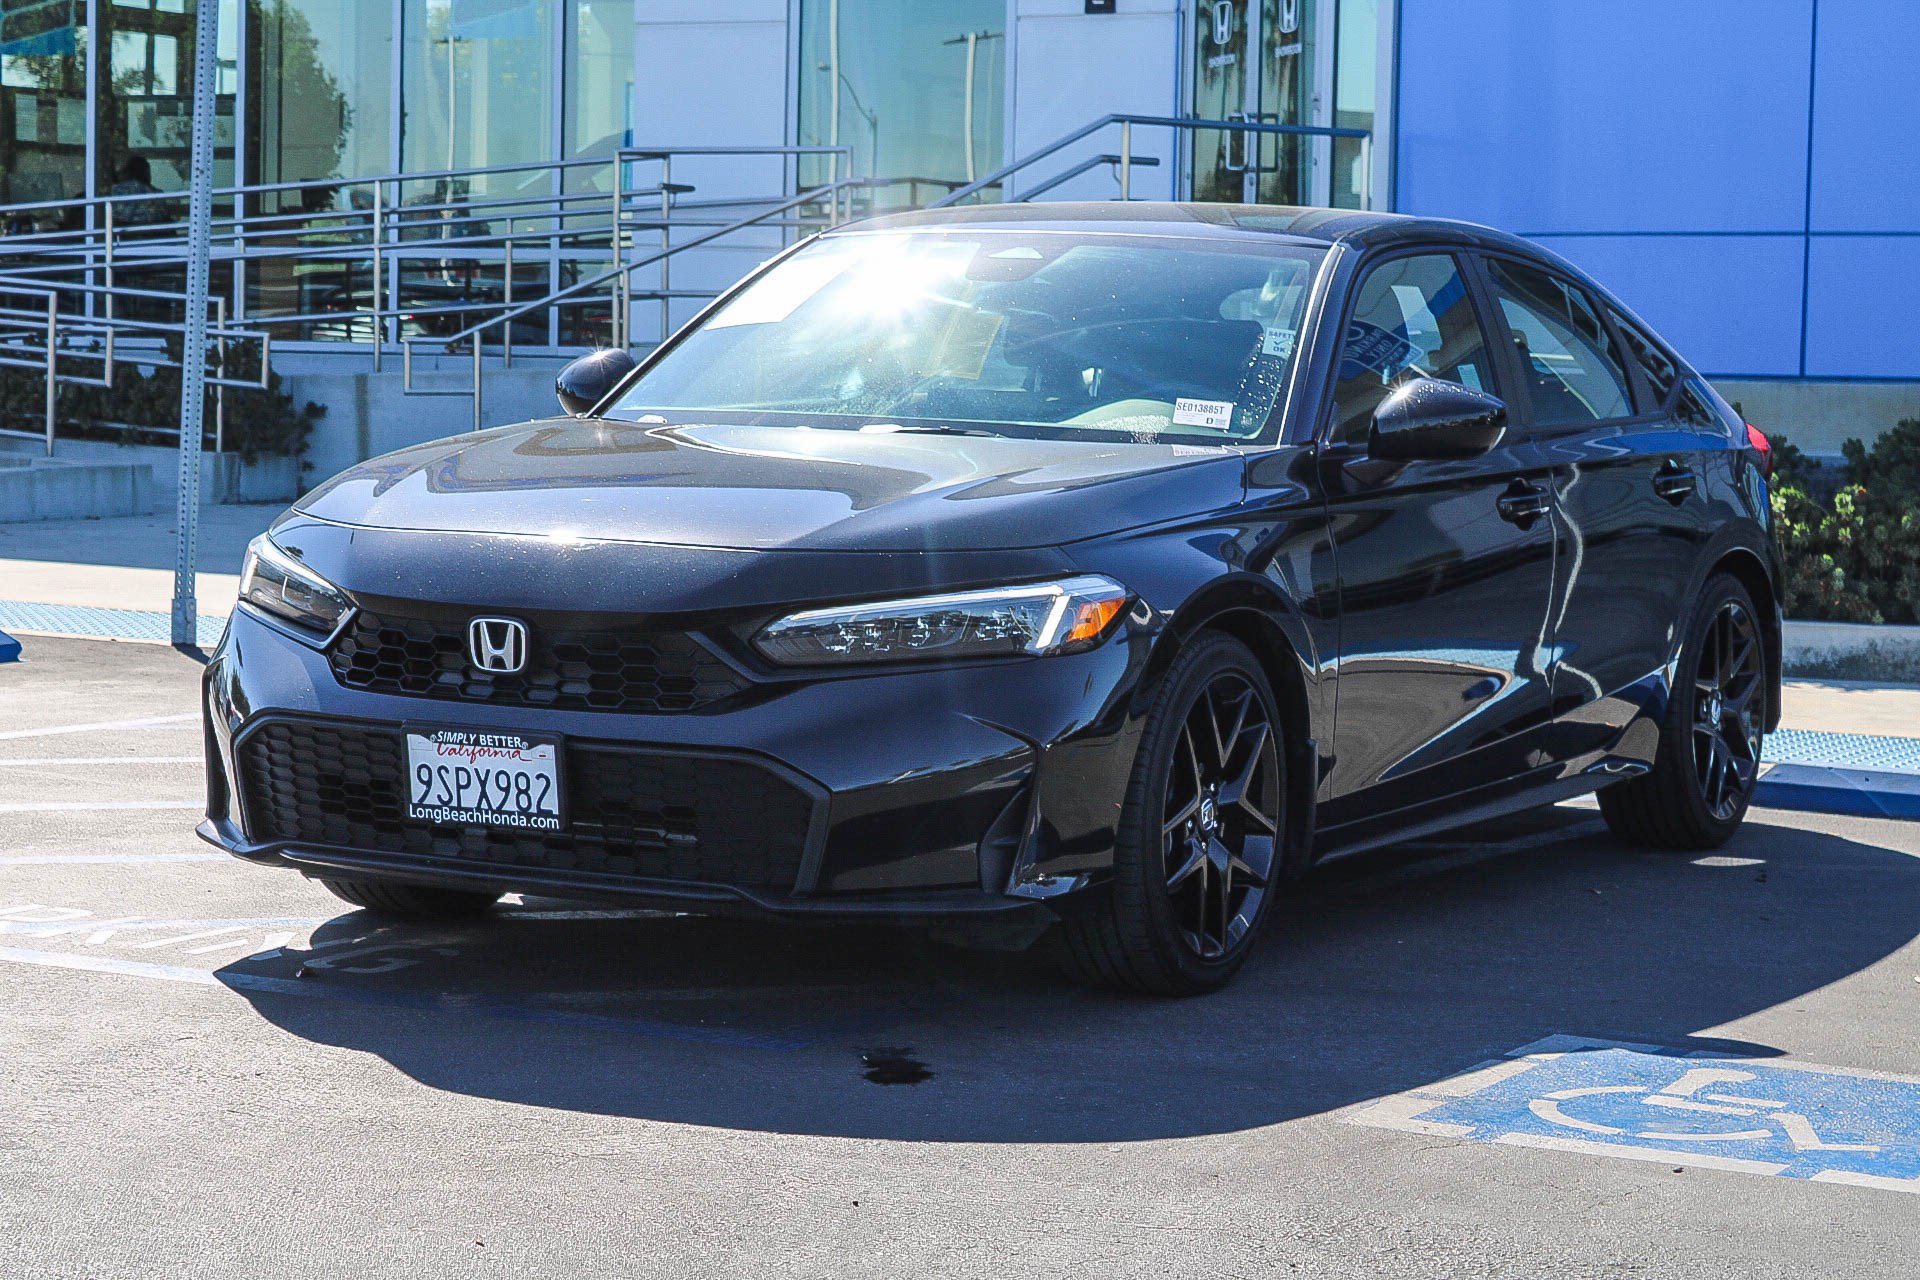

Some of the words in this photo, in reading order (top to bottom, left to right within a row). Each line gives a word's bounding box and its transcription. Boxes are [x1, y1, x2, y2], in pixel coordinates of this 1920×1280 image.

[436, 730, 477, 745] SIMPLY
[479, 734, 522, 749] BETTER
[436, 741, 532, 765] California
[416, 763, 554, 815] 9SPX982
[409, 804, 560, 830] LongBeachHonda.com
